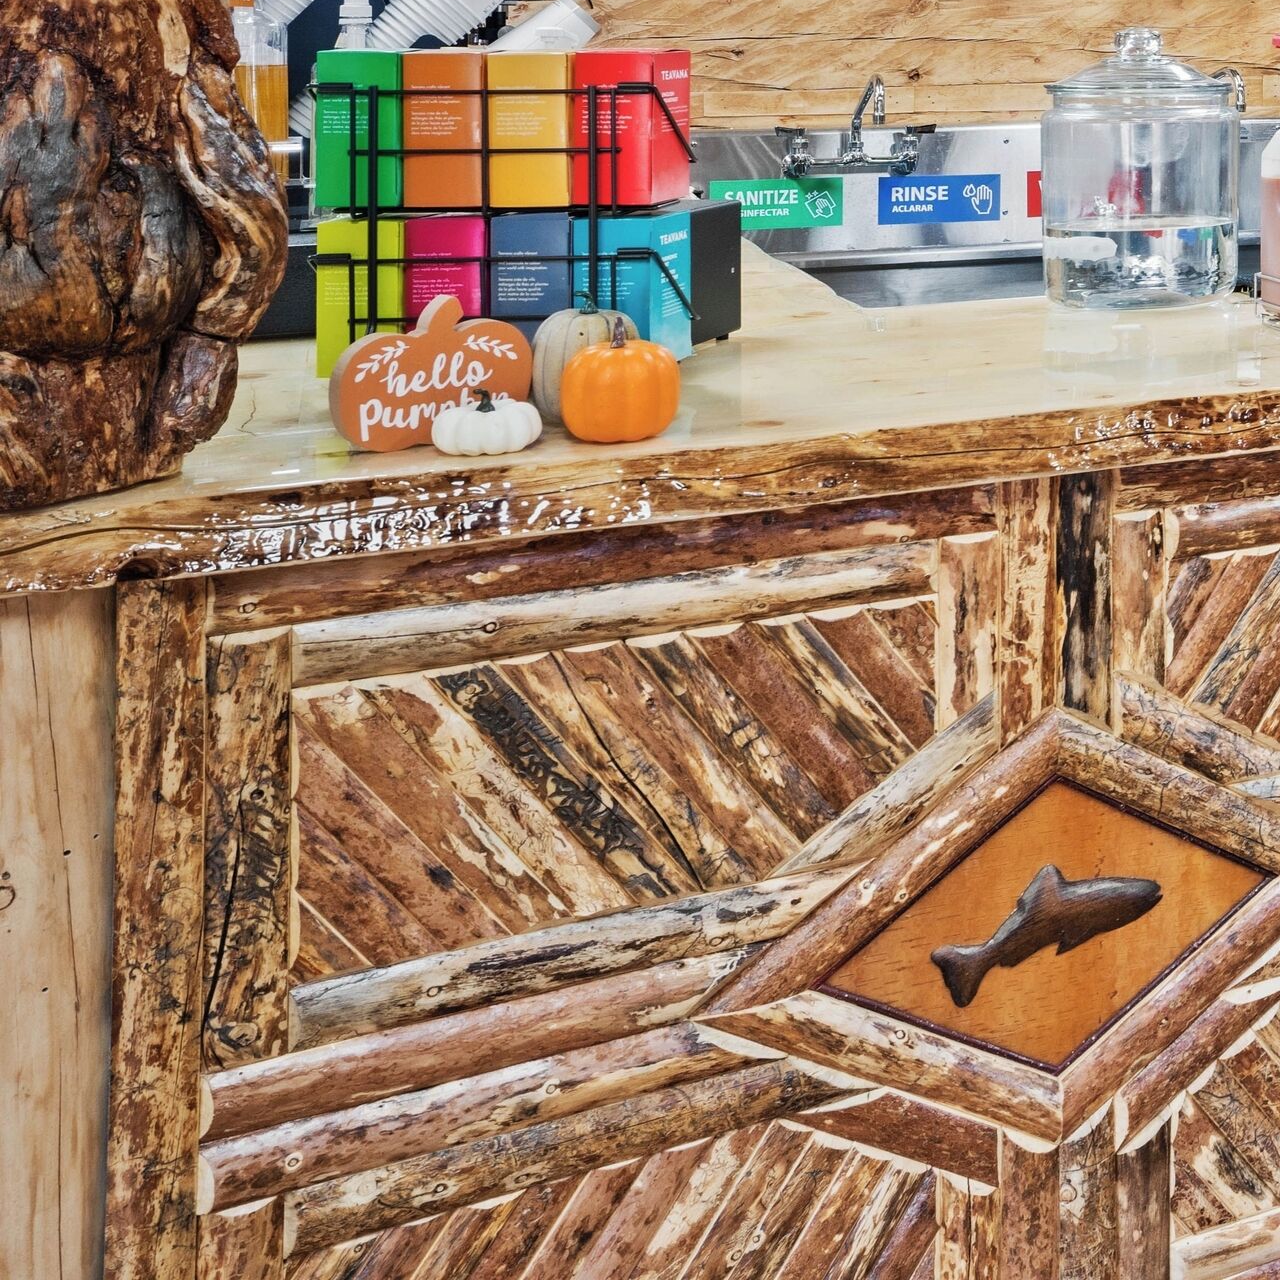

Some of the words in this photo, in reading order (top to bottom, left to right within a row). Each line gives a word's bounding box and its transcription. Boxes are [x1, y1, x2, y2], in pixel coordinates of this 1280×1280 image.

[661, 69, 688, 80] TEAVANA
[724, 189, 799, 206] SANITIZE
[891, 185, 949, 202] RINSE
[740, 208, 790, 218] SINFECTAR
[892, 204, 934, 213] ACLARAR
[660, 229, 688, 245] TEAVANA
[379, 351, 493, 397] hello
